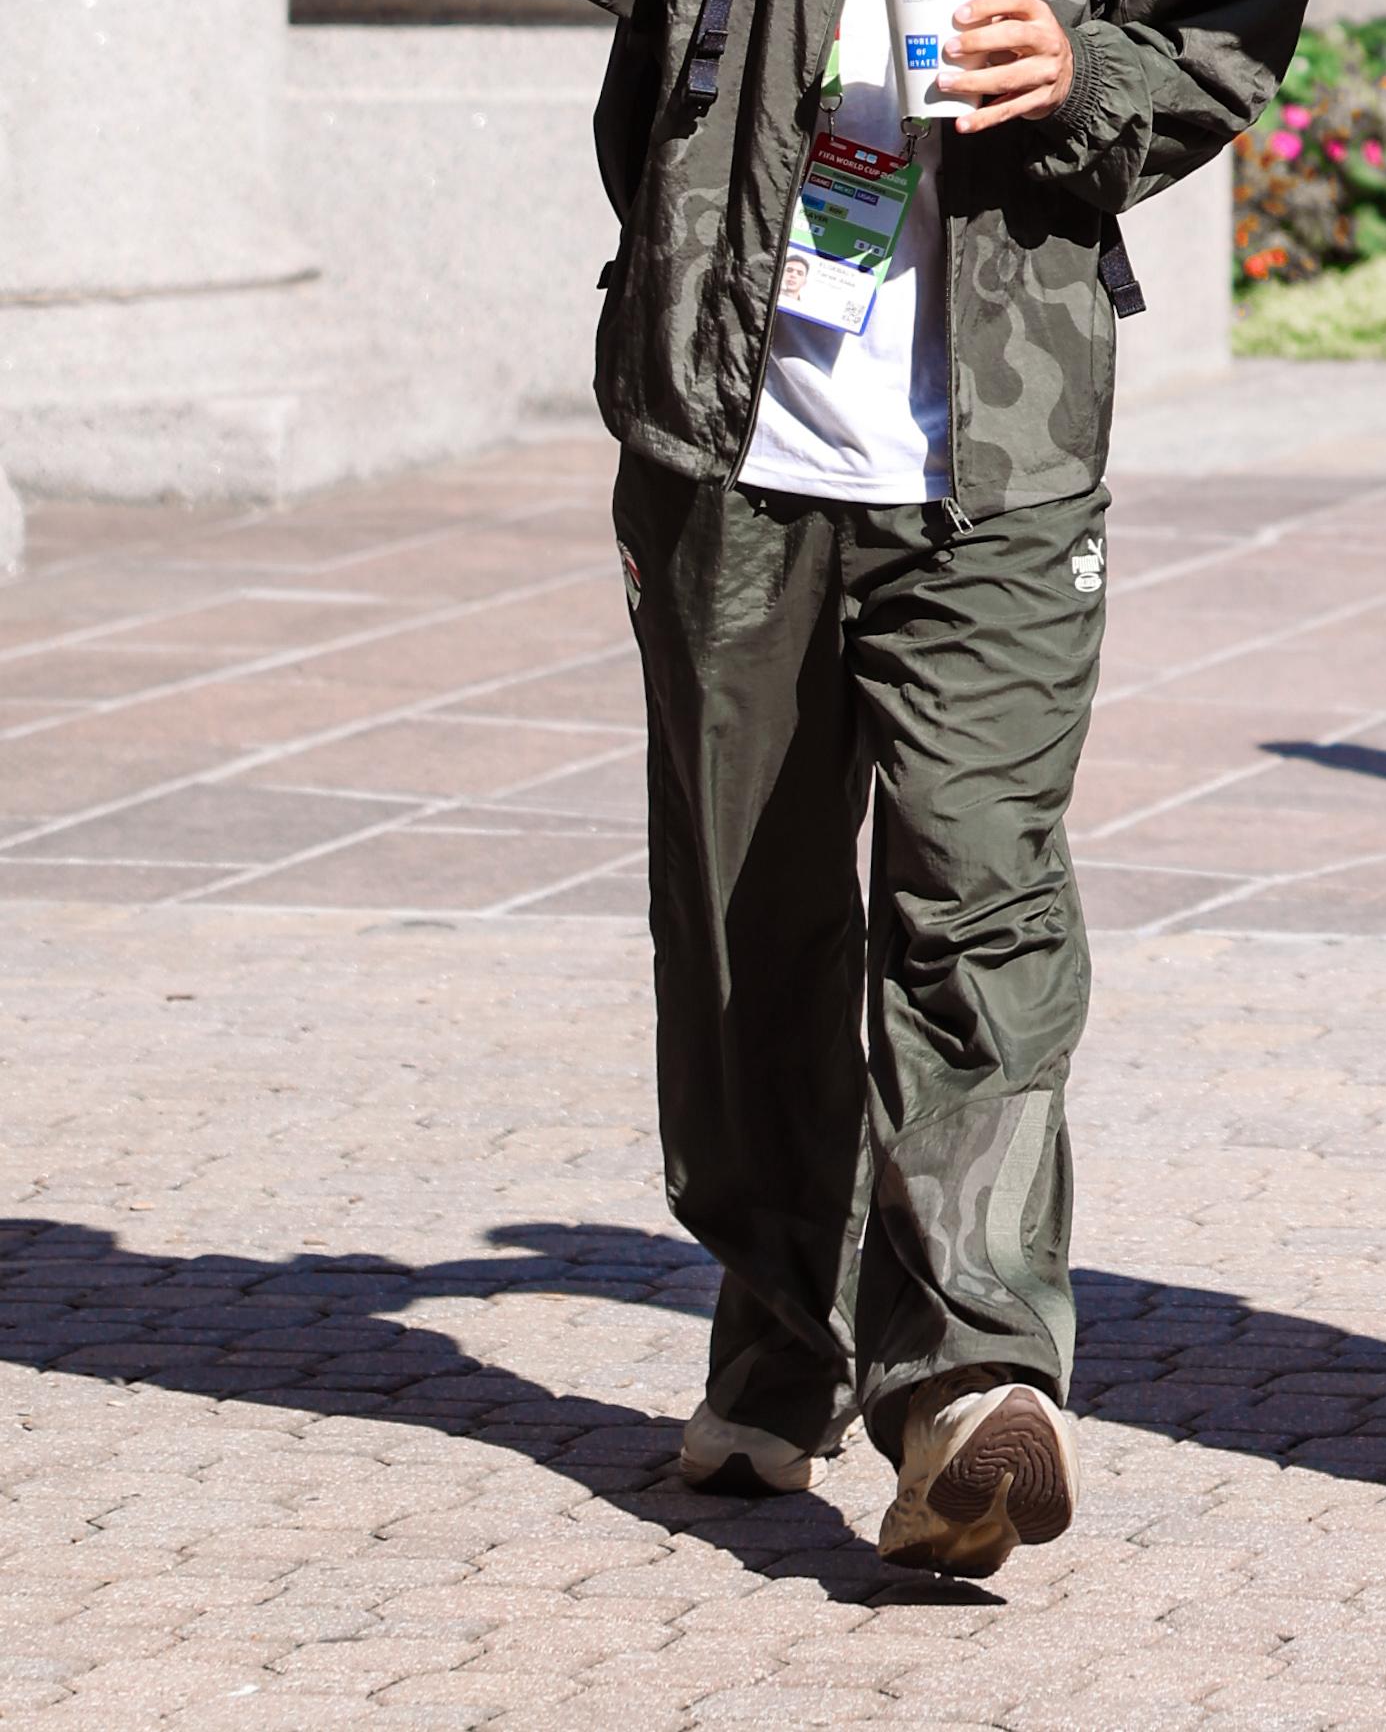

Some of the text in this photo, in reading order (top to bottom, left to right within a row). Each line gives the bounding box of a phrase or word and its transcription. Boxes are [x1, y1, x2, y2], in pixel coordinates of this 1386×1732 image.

[907, 37, 936, 45] WORLD
[916, 47, 927, 56] OF
[909, 58, 936, 67] HYATT
[818, 150, 835, 162] FIFA
[836, 155, 863, 171] WORLD
[864, 166, 880, 176] CUP
